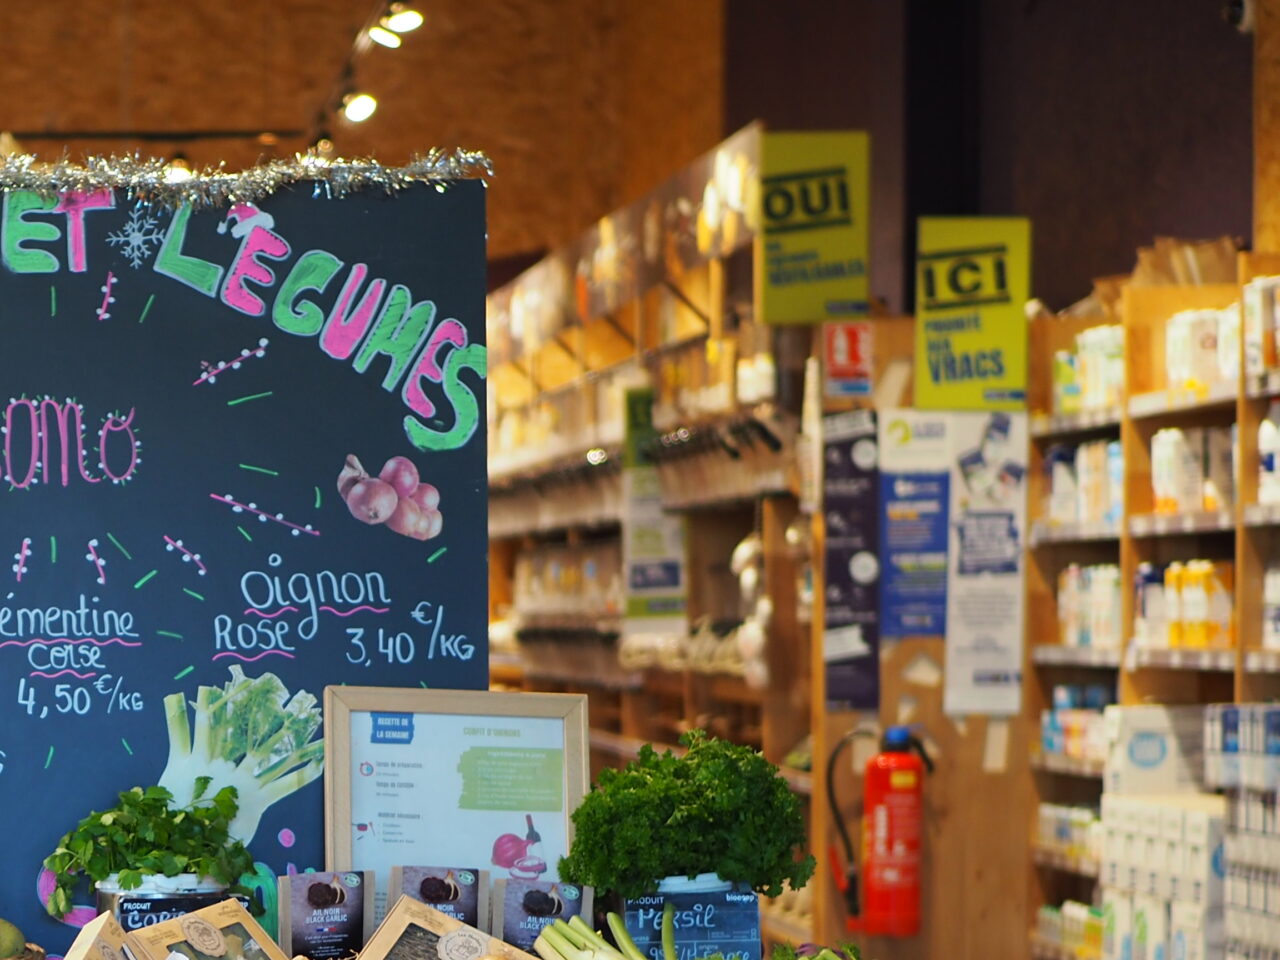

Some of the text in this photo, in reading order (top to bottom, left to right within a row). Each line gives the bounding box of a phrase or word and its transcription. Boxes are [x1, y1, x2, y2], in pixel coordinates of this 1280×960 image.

[762, 178, 849, 222] OUI
[1, 187, 116, 274] ET
[923, 257, 1008, 300] ICI
[928, 350, 1005, 384] VRACS
[241, 553, 391, 640] Oignon
[324, 908, 341, 916] NOIR
